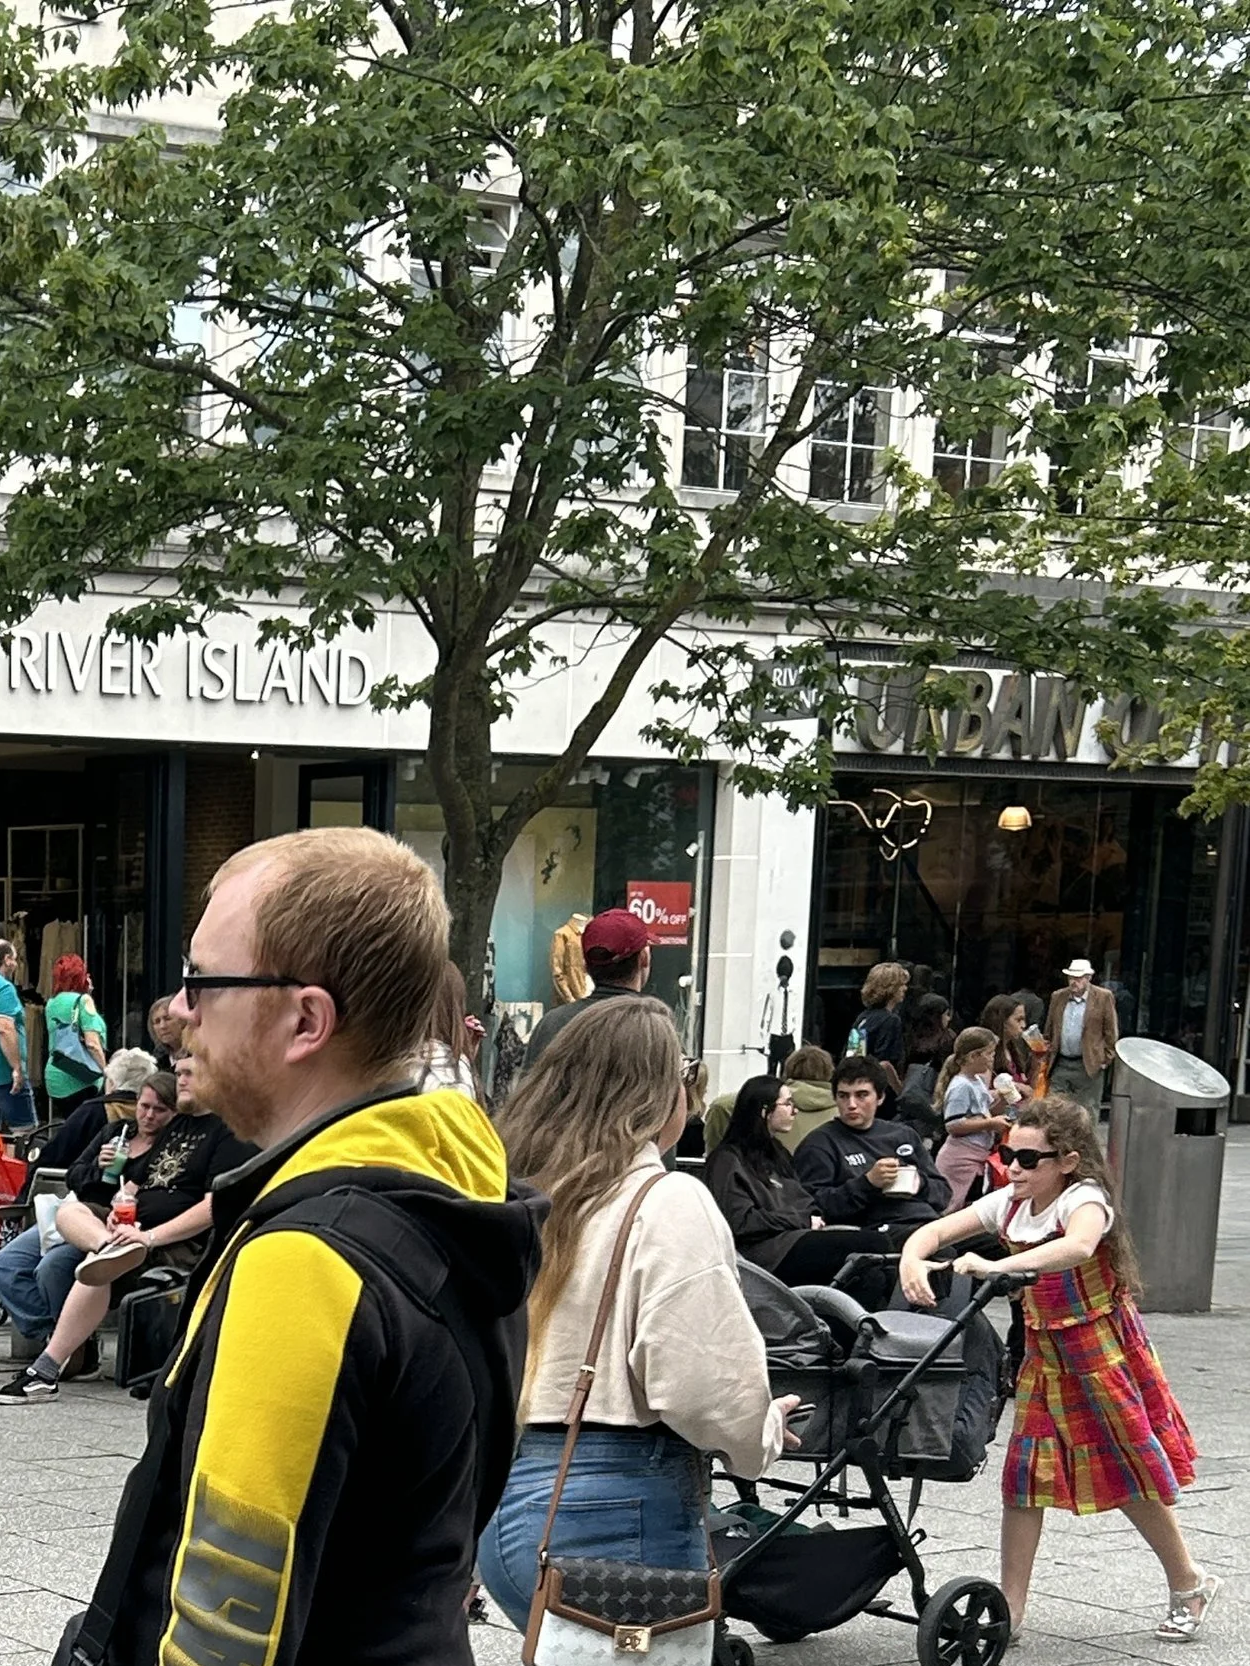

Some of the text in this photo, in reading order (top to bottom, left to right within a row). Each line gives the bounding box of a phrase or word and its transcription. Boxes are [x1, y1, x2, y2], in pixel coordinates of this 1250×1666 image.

[9, 629, 375, 706] RIVER ISLAND
[854, 666, 1087, 760] URBAN
[629, 898, 687, 925] 60% OFF
